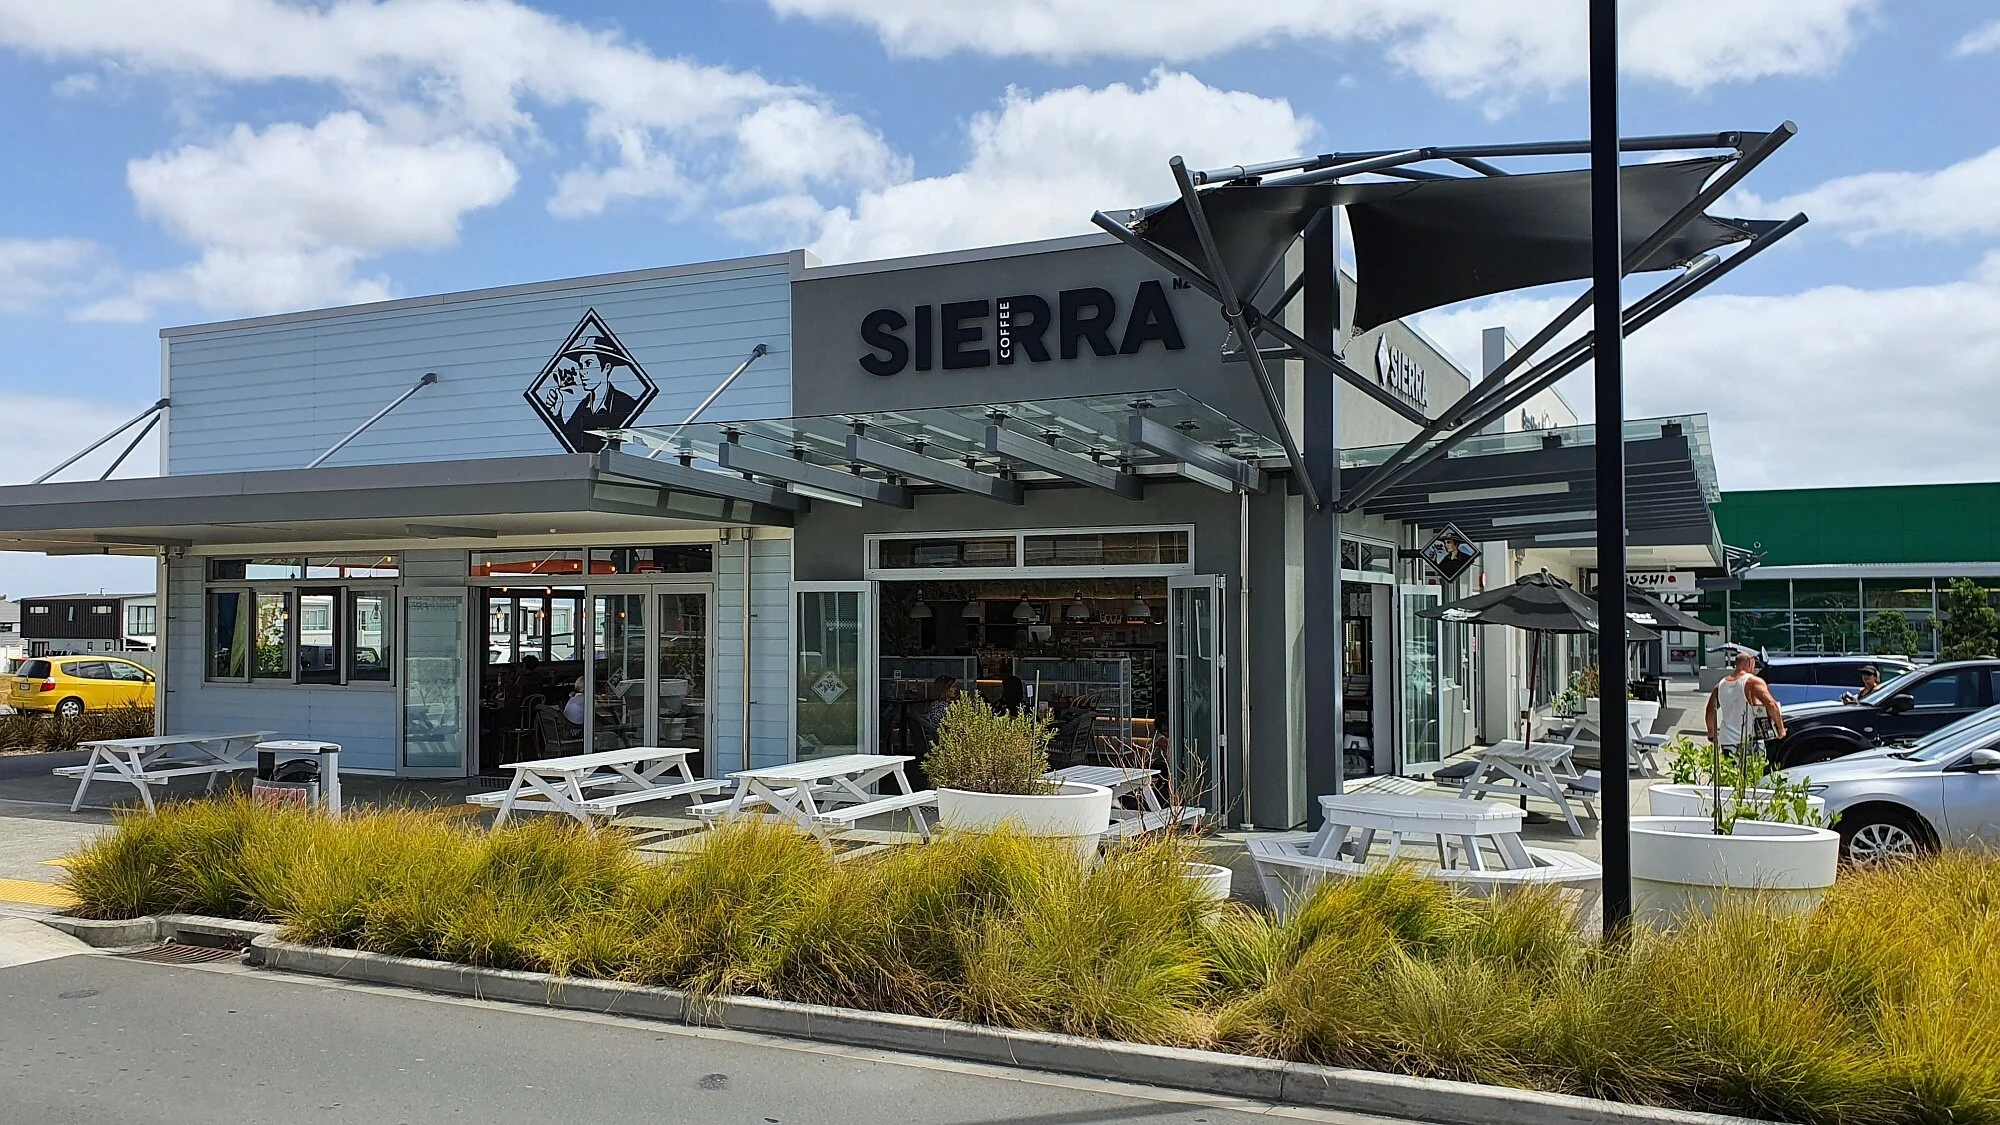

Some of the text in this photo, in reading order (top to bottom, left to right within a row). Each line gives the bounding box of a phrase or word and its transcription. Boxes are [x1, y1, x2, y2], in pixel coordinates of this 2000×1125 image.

[858, 280, 1186, 377] SIERRA
[1000, 301, 1010, 358] COFFEE
[1388, 345, 1428, 408] SIERRA
[1626, 574, 1665, 586] USHI
